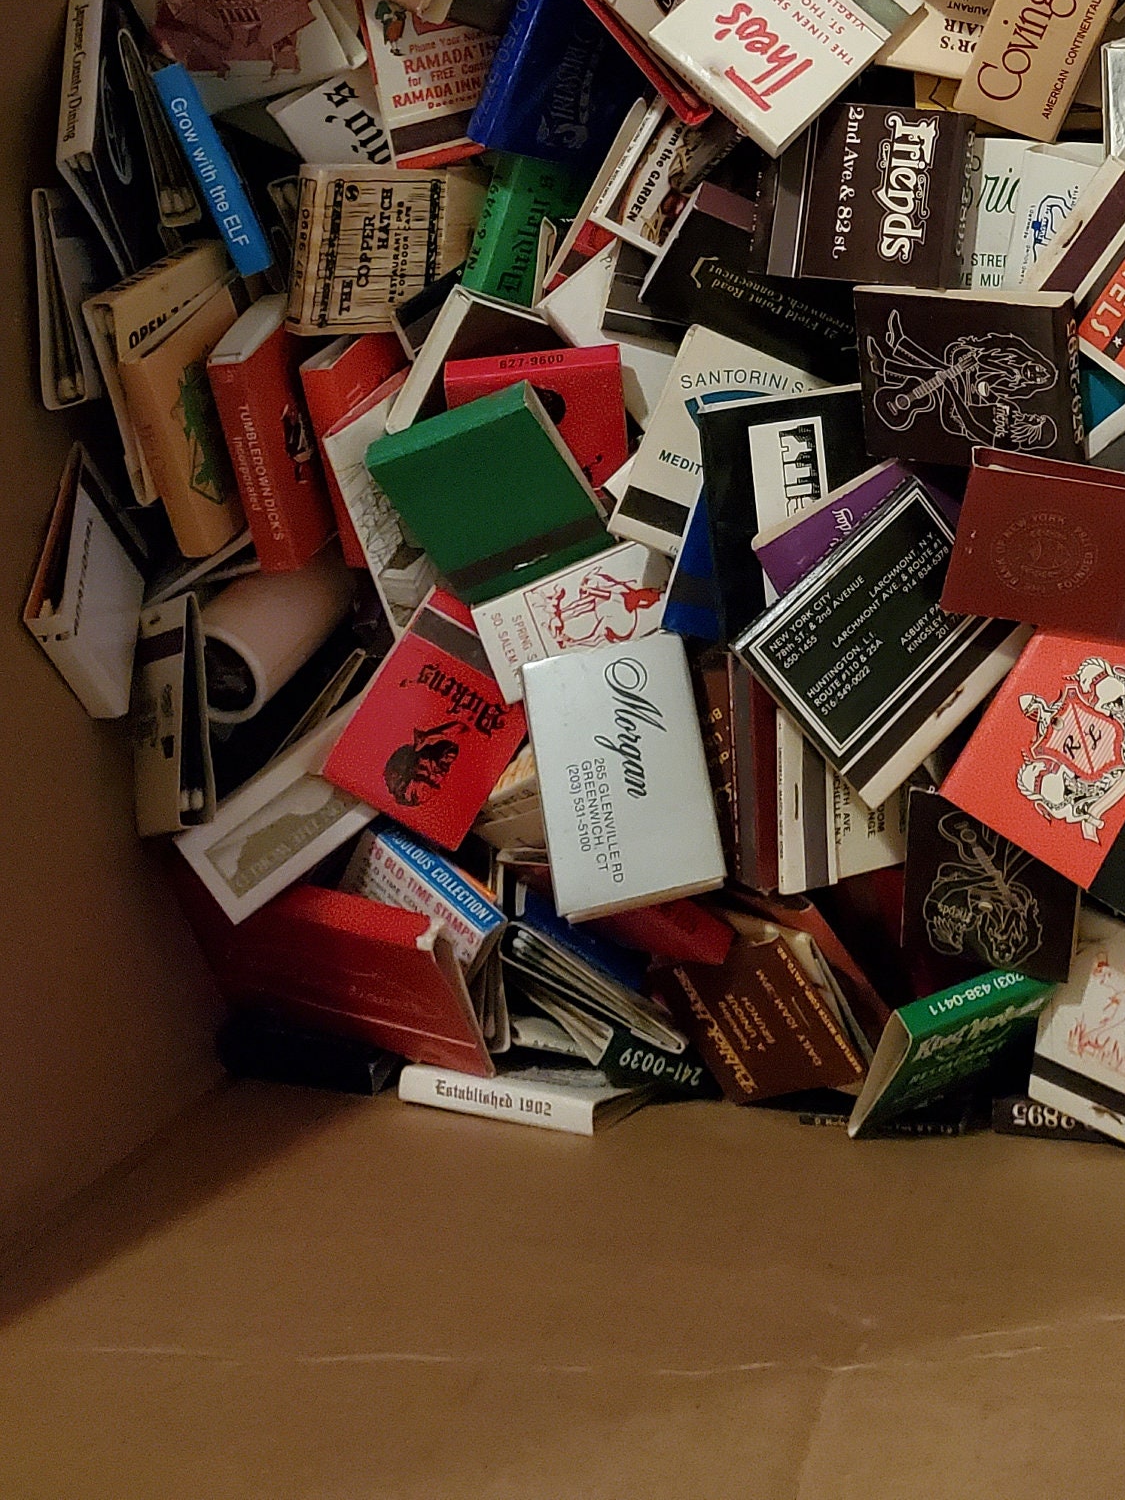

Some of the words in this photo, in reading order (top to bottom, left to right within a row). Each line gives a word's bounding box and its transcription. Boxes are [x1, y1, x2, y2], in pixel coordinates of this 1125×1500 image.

[790, 10, 830, 48] LINEN
[401, 45, 474, 75] RAMADA
[715, 3, 813, 112] Theo's
[829, 39, 854, 66] THE
[391, 84, 455, 109] RAMADA
[454, 76, 482, 95] INN
[406, 74, 423, 87] for
[428, 67, 455, 82] FREE
[1041, 69, 1070, 120] AMERICAN
[62, 95, 84, 143] Dining
[847, 105, 865, 144] 2nd
[170, 96, 199, 144] Grow
[192, 143, 216, 184] with
[208, 183, 231, 213] the
[222, 214, 250, 248] ELF
[872, 110, 940, 265] Friends
[626, 172, 663, 223] GARDEN
[837, 187, 855, 205] &
[377, 187, 394, 250] HATCH
[357, 214, 376, 288] COPPER
[338, 279, 353, 316] THE
[703, 262, 786, 304] Connecticut
[708, 275, 745, 299] Road
[745, 292, 784, 316] Point
[680, 368, 790, 392] SANTORINI
[238, 405, 273, 497] TUMBLEDOWN
[263, 496, 285, 542] DICKS
[833, 574, 866, 612] AVENUE
[868, 548, 920, 599] LARCHMONT,
[509, 613, 532, 652] SPRING
[768, 631, 792, 654] NEW
[787, 611, 813, 638] YORK
[809, 591, 833, 616] CITY
[831, 601, 883, 649] LARCHMONT
[900, 614, 929, 648] ASBURY
[783, 635, 818, 669] 650-1455
[806, 645, 863, 699] HUNTINGTON,
[594, 657, 667, 799] Morgan
[566, 764, 582, 794] (203)
[593, 757, 606, 781] 265
[573, 795, 592, 853] 531-5100
[598, 783, 621, 861] GLENVILLE
[596, 852, 610, 871] CT
[611, 863, 624, 884] RD
[431, 861, 493, 924] COLLECTION!
[928, 976, 993, 1016] 438-0411
[618, 1047, 703, 1086] 241-0039
[435, 1078, 513, 1110] Established
[519, 1096, 553, 1116] 1902
